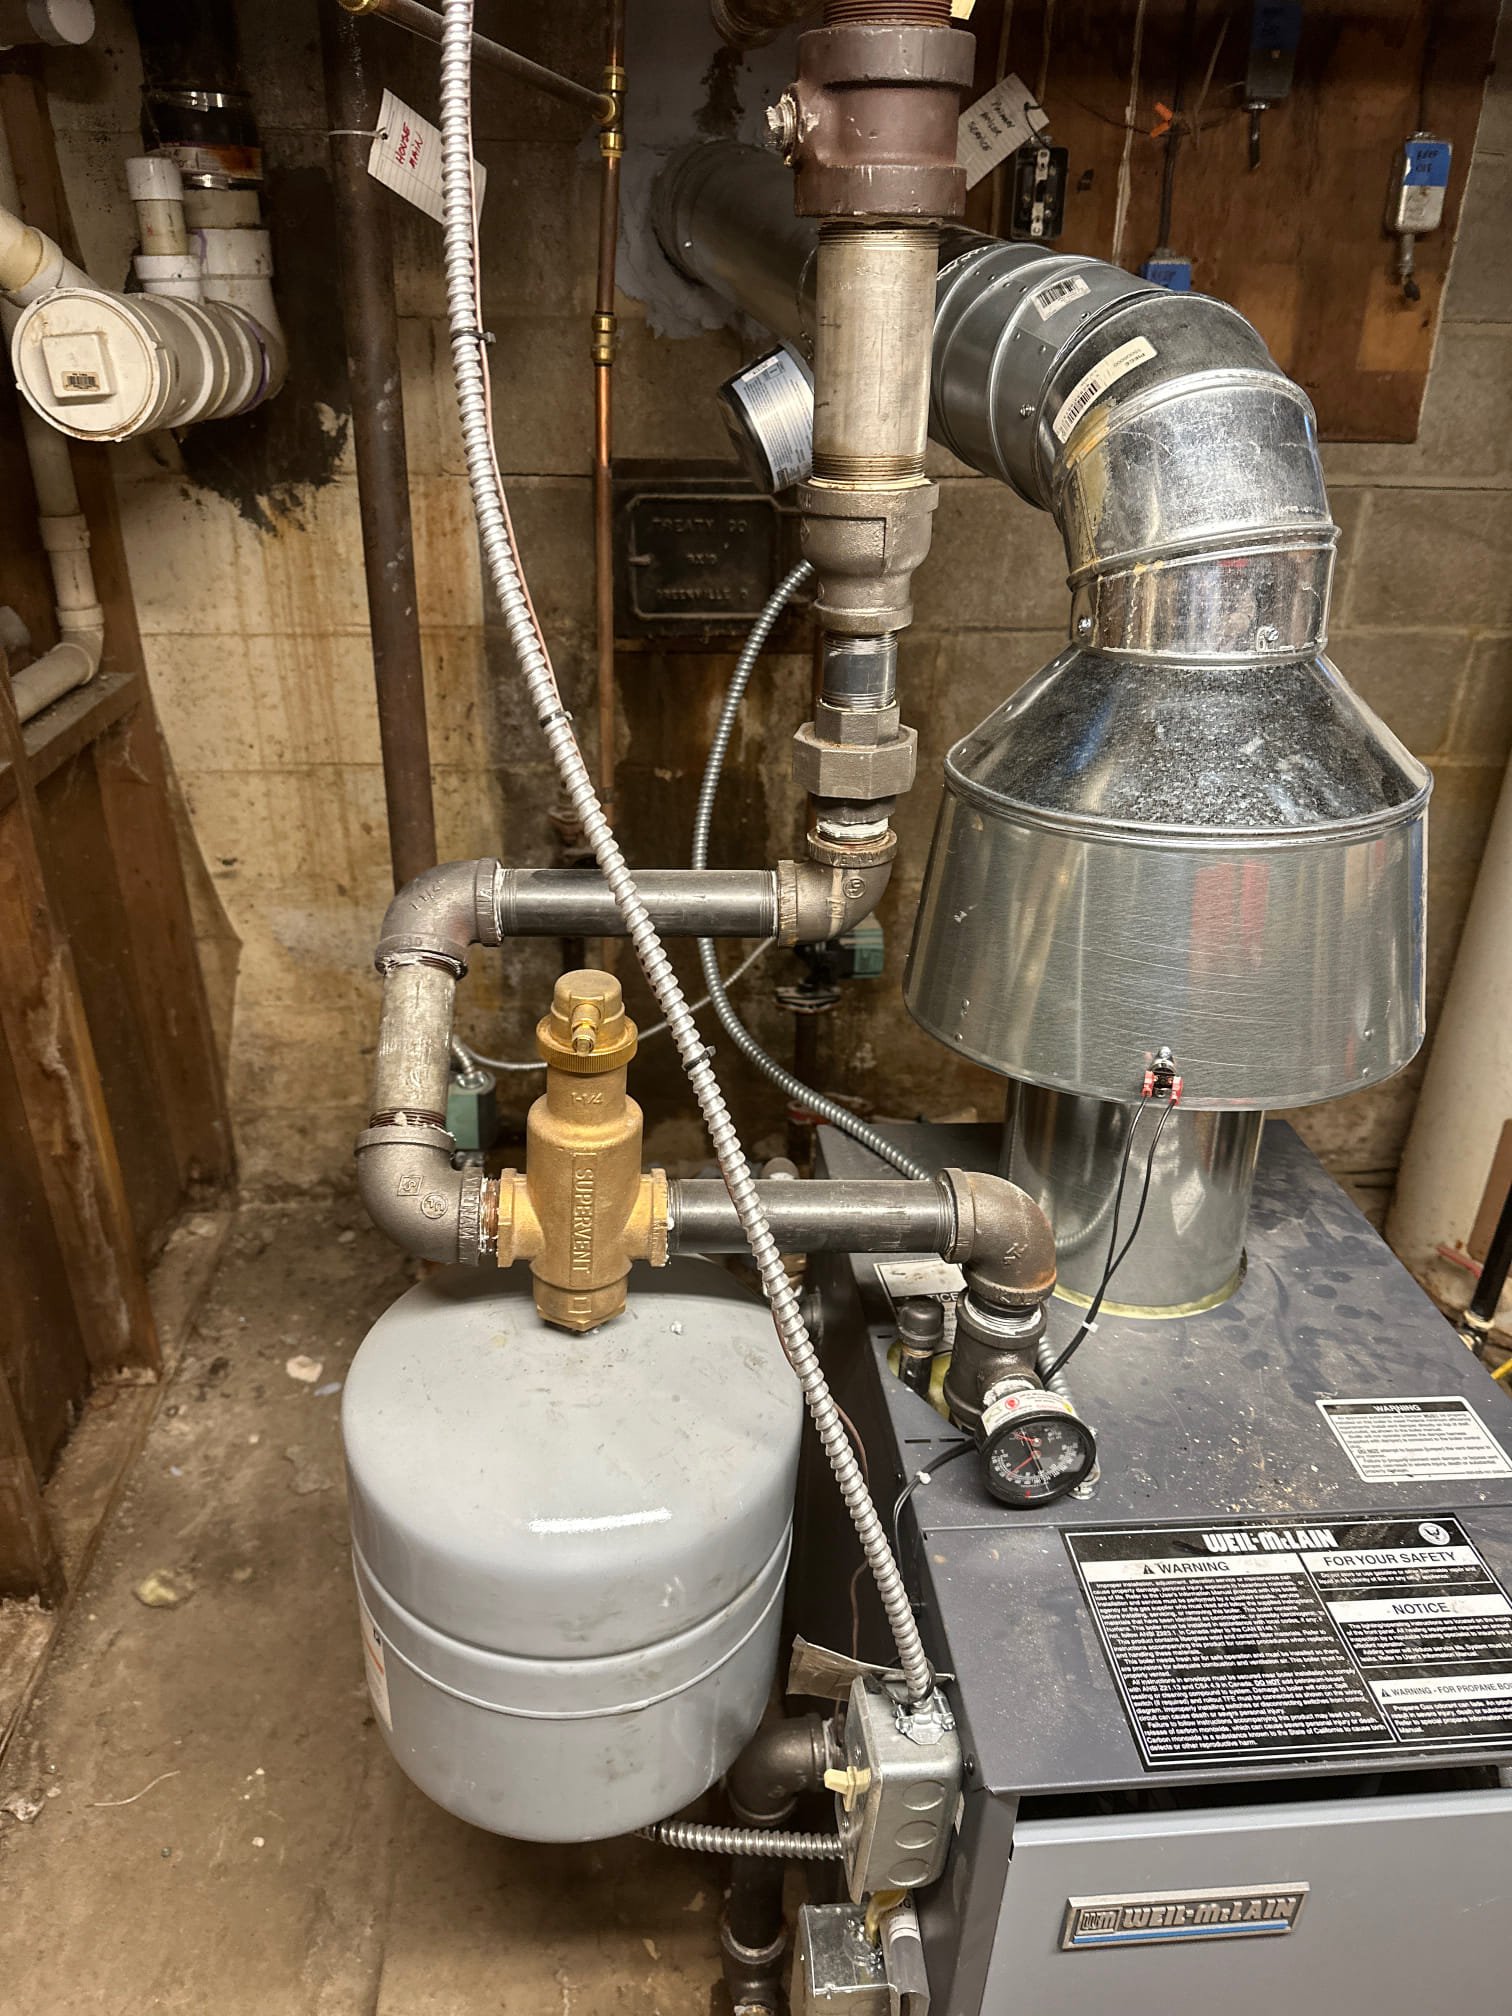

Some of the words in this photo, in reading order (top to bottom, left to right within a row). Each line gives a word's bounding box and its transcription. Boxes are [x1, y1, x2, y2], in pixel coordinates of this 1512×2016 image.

[394, 122, 412, 165] HOUSE
[574, 1167, 595, 1275] SUPERVENT
[1373, 1404, 1422, 1413] WARNING
[1324, 1556, 1356, 1566] FOR
[1355, 1554, 1398, 1566] YOUR
[1400, 1552, 1456, 1564] SAFETY
[1158, 1560, 1230, 1575] WARNING
[1392, 1602, 1450, 1616] NOTICE
[1391, 1686, 1432, 1696] WARNING
[1437, 1685, 1456, 1694] FOR
[1456, 1683, 1498, 1693] PROPANE
